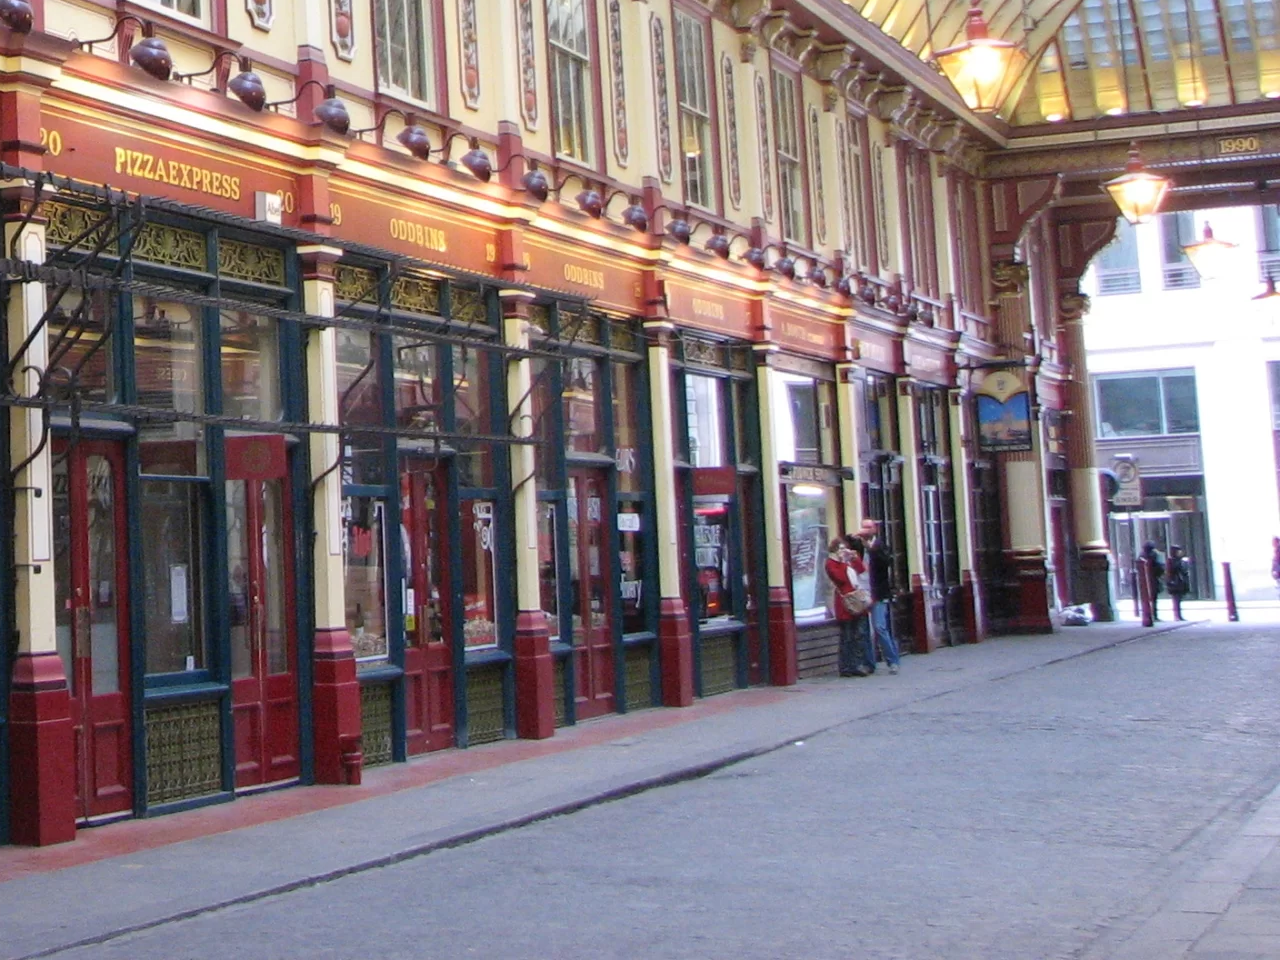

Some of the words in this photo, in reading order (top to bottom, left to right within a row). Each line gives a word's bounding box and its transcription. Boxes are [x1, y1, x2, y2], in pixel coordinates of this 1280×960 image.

[1220, 137, 1257, 153] 1990
[114, 146, 242, 201] PIZZAEXPRESS
[329, 202, 342, 226] 19
[389, 218, 447, 253] ODDBINS
[563, 262, 605, 290] ODDBINS
